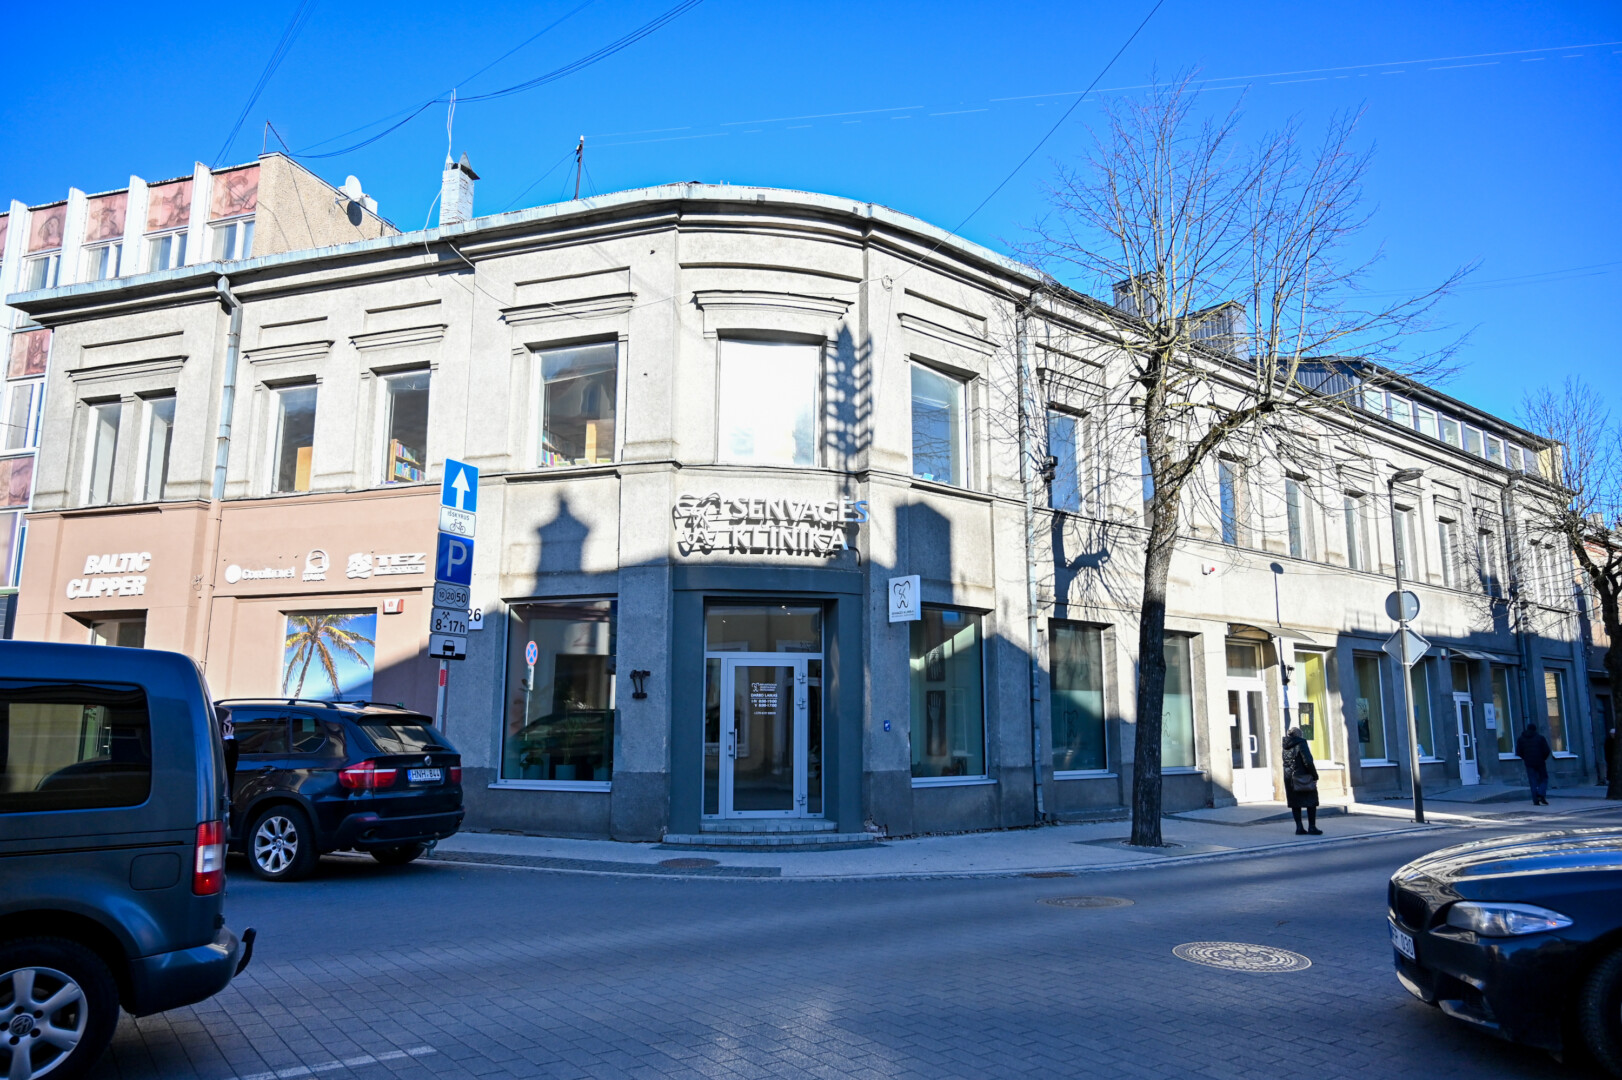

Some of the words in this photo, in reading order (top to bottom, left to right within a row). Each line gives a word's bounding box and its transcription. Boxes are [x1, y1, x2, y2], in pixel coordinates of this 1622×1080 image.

[732, 495, 869, 522] SENVAGĖS
[732, 525, 849, 551] KLINIKA
[83, 552, 152, 575] BALTIC
[375, 553, 427, 567] TEZ
[446, 539, 467, 577] P
[66, 576, 147, 600] CLIPPER
[446, 592, 455, 600] 20
[455, 592, 467, 604] 50
[468, 608, 482, 622] 26
